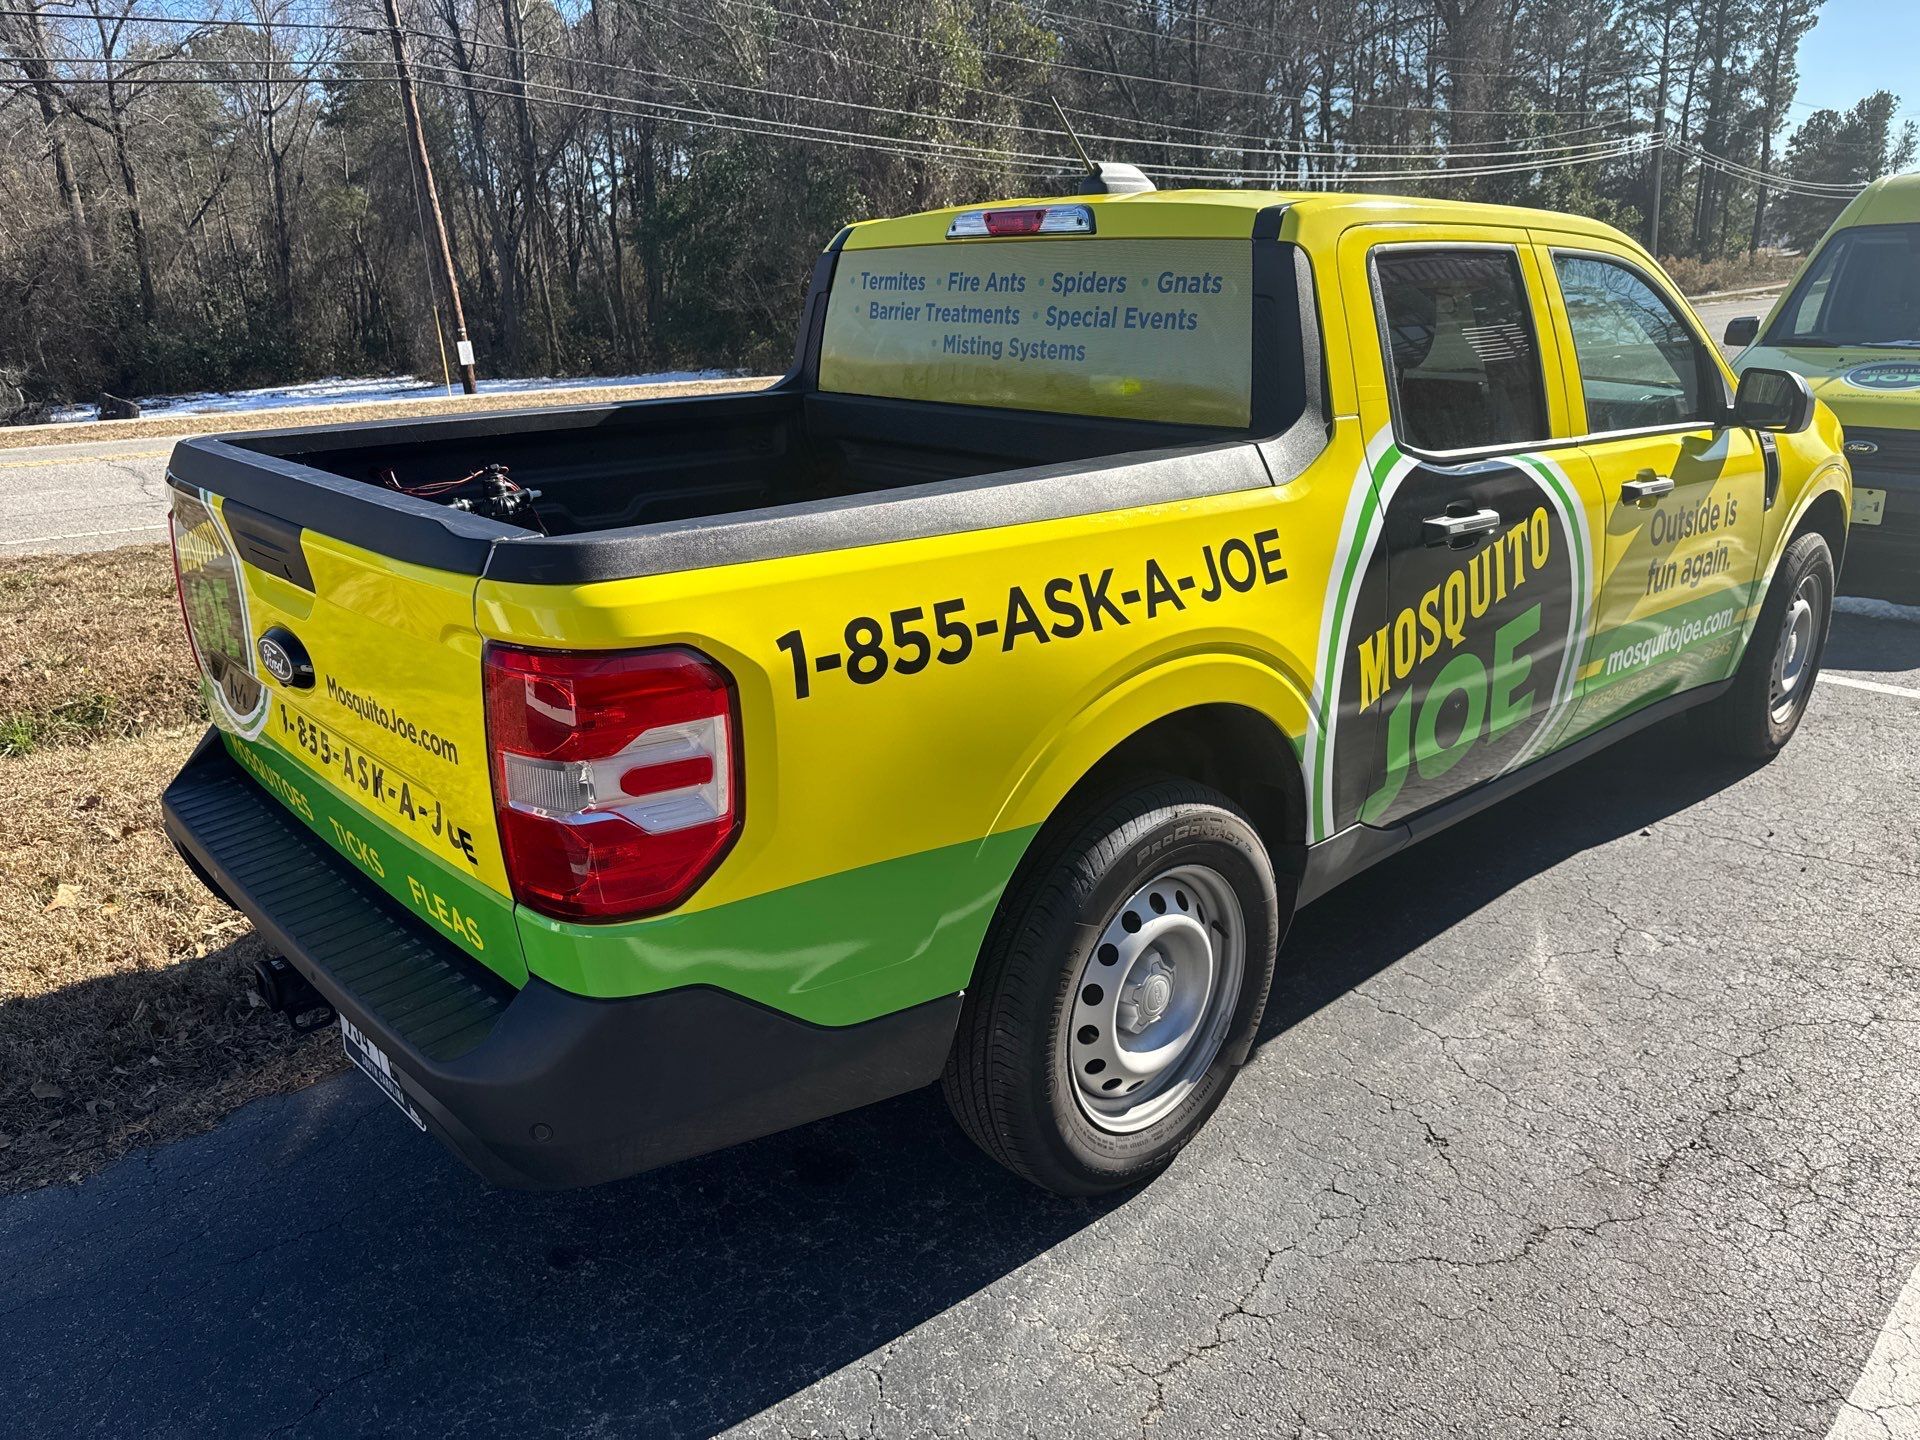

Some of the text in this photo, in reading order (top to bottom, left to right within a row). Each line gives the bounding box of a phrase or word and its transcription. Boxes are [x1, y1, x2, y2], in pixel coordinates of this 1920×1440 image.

[861, 270, 1222, 296] Termites Fire Ants Spiders Gnats
[869, 301, 1198, 331] Barrier Treatments Special Events
[943, 334, 1086, 362] Misting Systems
[1650, 492, 1738, 546] Outside is
[1645, 541, 1730, 596] fun again.
[776, 528, 1288, 700] 1-855-ASK-A-JOE
[1358, 506, 1550, 715] MOSQUITO
[1606, 606, 1733, 676] mosquitojoe.com
[326, 674, 459, 765] MosquitoJoe.com
[1355, 602, 1541, 823] JOE
[280, 704, 479, 866] 1-855-ASK-A-JOE
[229, 734, 485, 951] MOSQUITOES TICKS FLEAS
